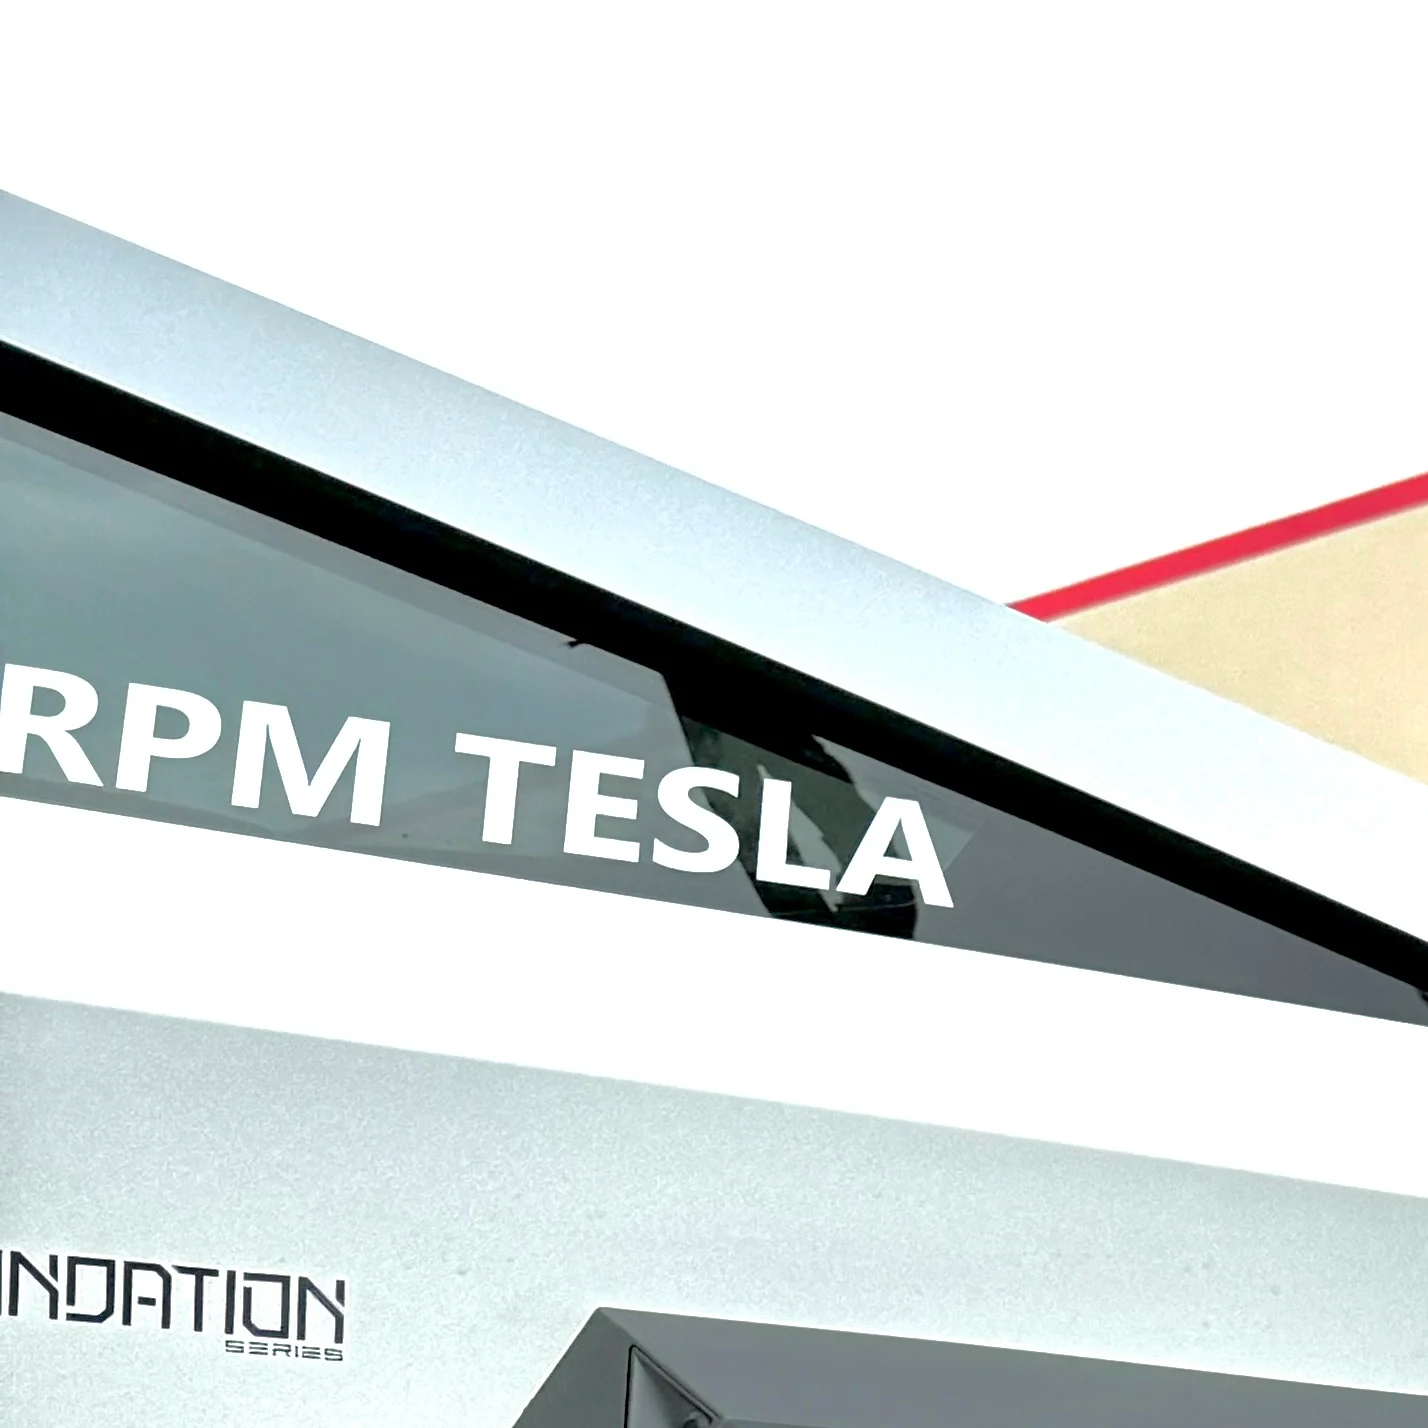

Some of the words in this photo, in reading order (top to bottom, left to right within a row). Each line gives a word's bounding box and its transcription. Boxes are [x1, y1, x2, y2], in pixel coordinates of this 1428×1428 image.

[0, 662, 391, 828] RPM
[454, 732, 956, 909] TESLA
[0, 1249, 346, 1344] NDATION
[224, 1339, 344, 1362] SERIES
